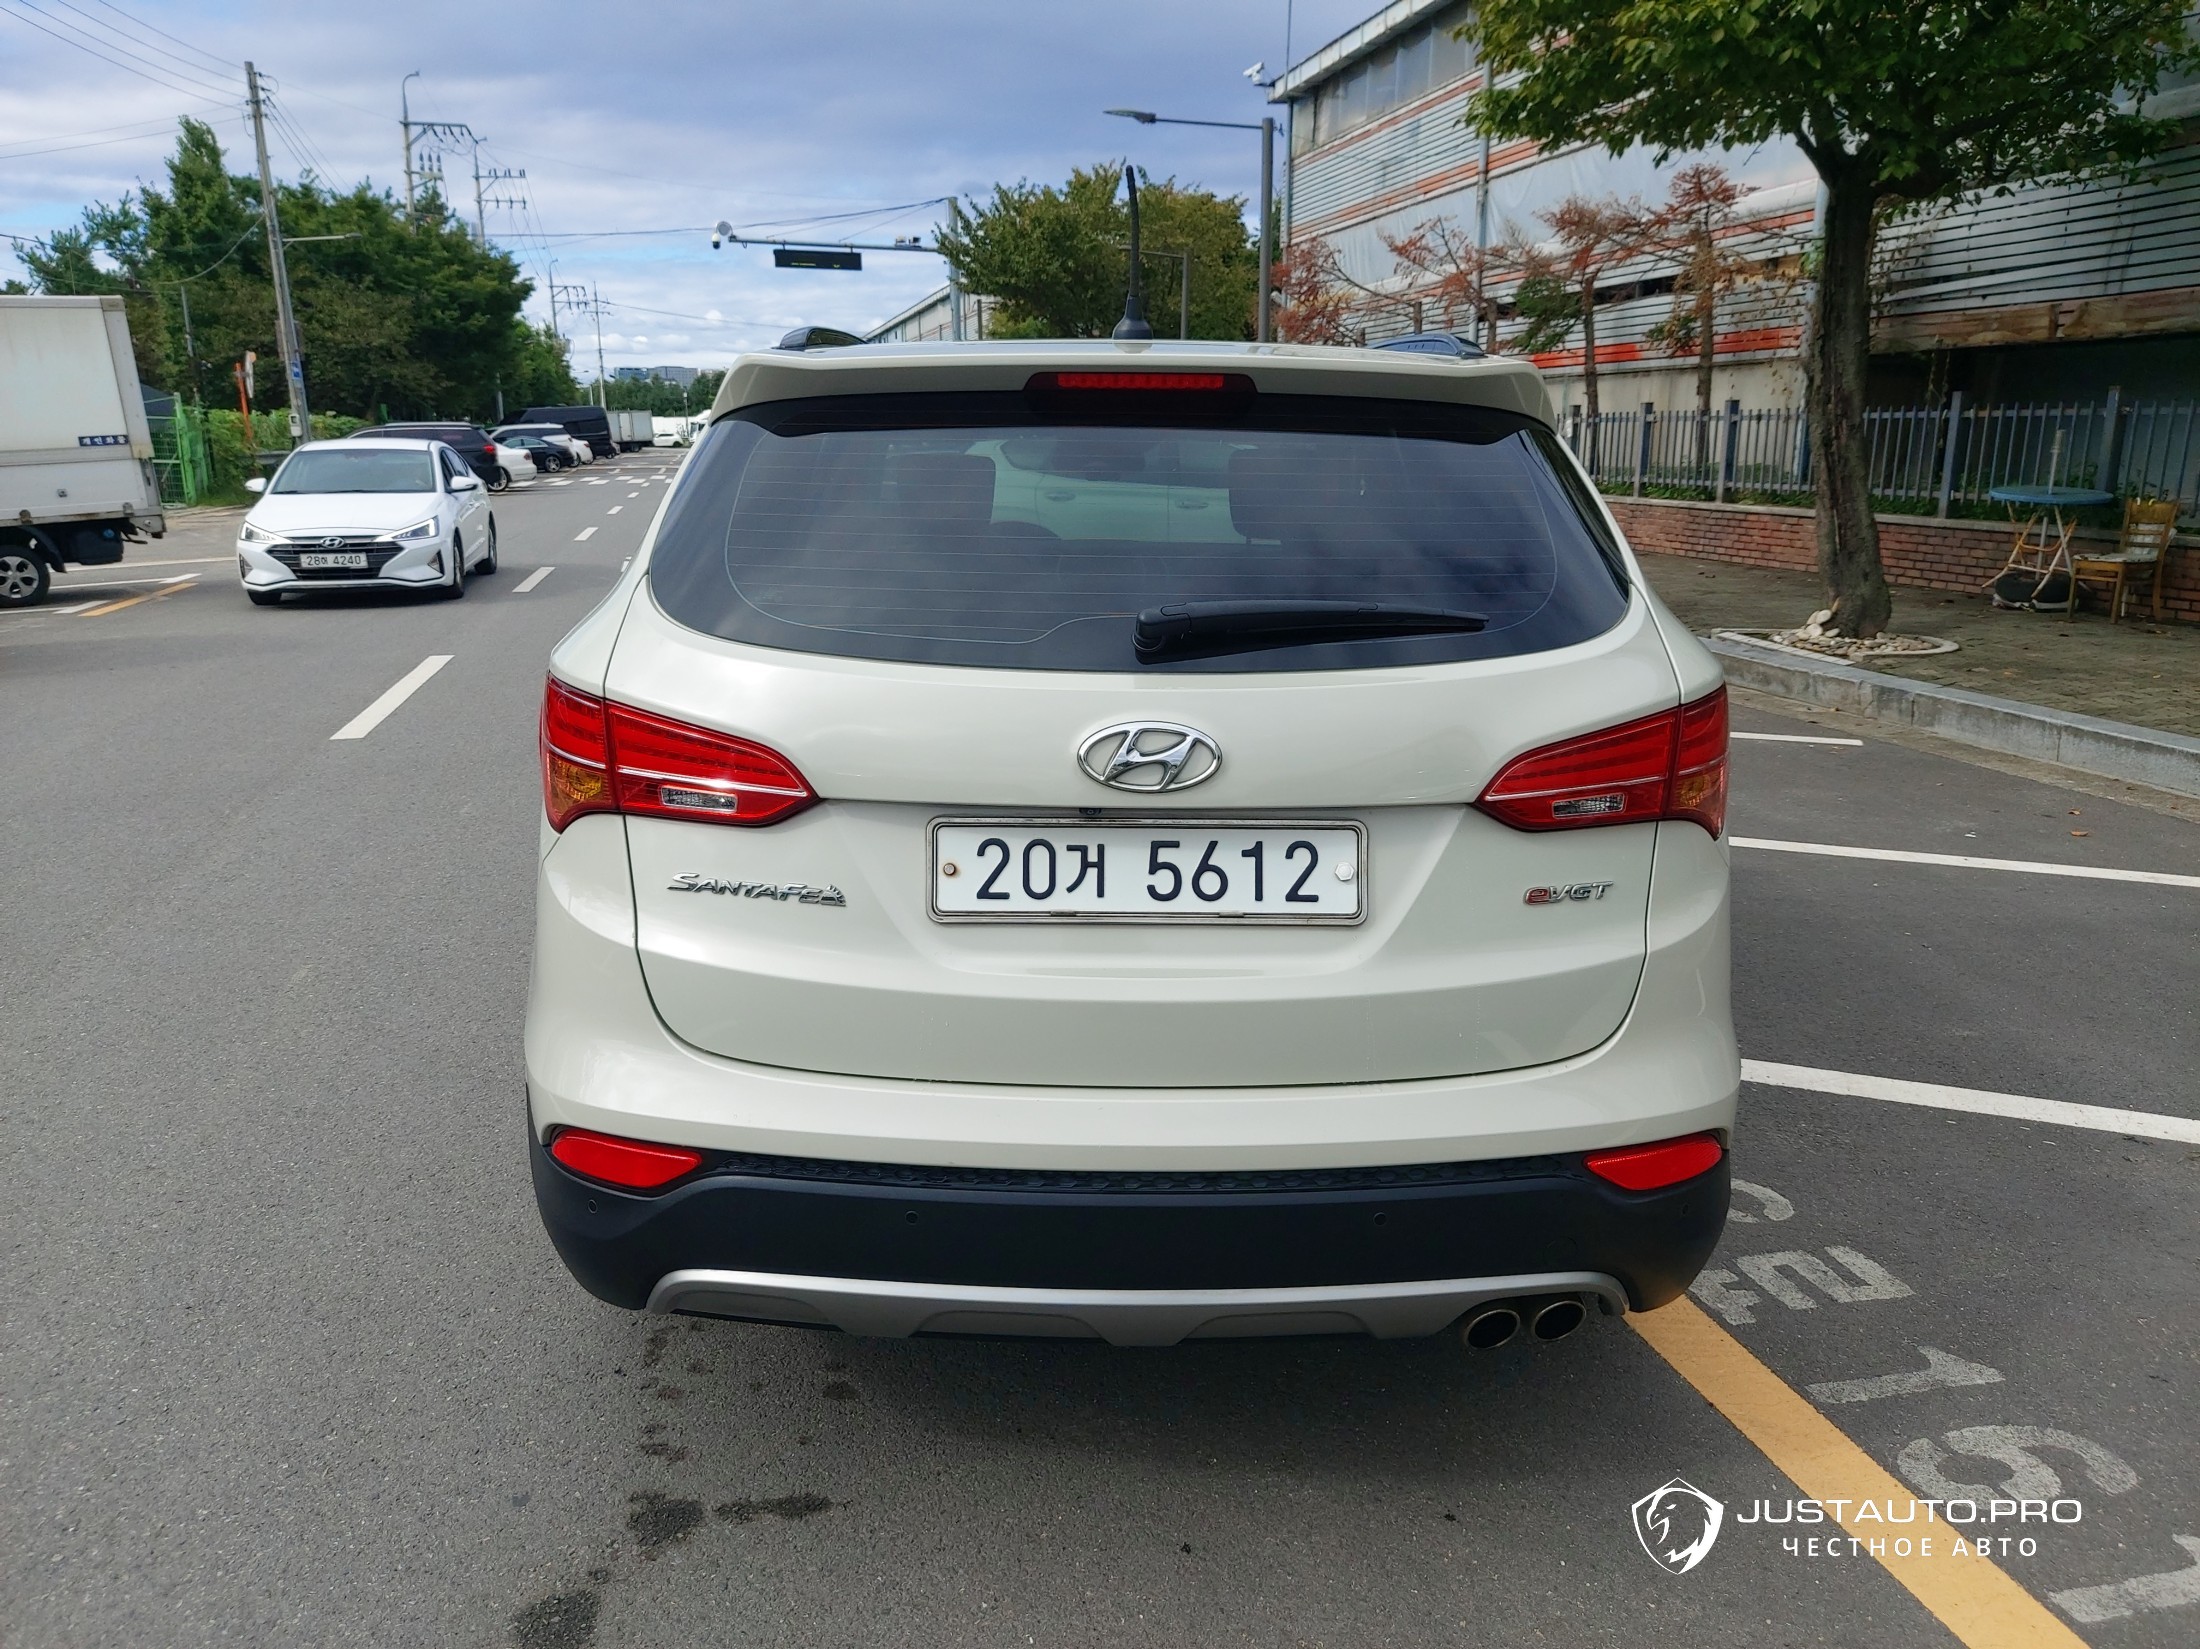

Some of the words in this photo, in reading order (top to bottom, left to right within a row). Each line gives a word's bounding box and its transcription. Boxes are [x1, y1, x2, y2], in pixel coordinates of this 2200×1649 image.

[333, 555, 361, 566] 4240
[976, 837, 1105, 900] 20거
[1146, 840, 1320, 902] 5612
